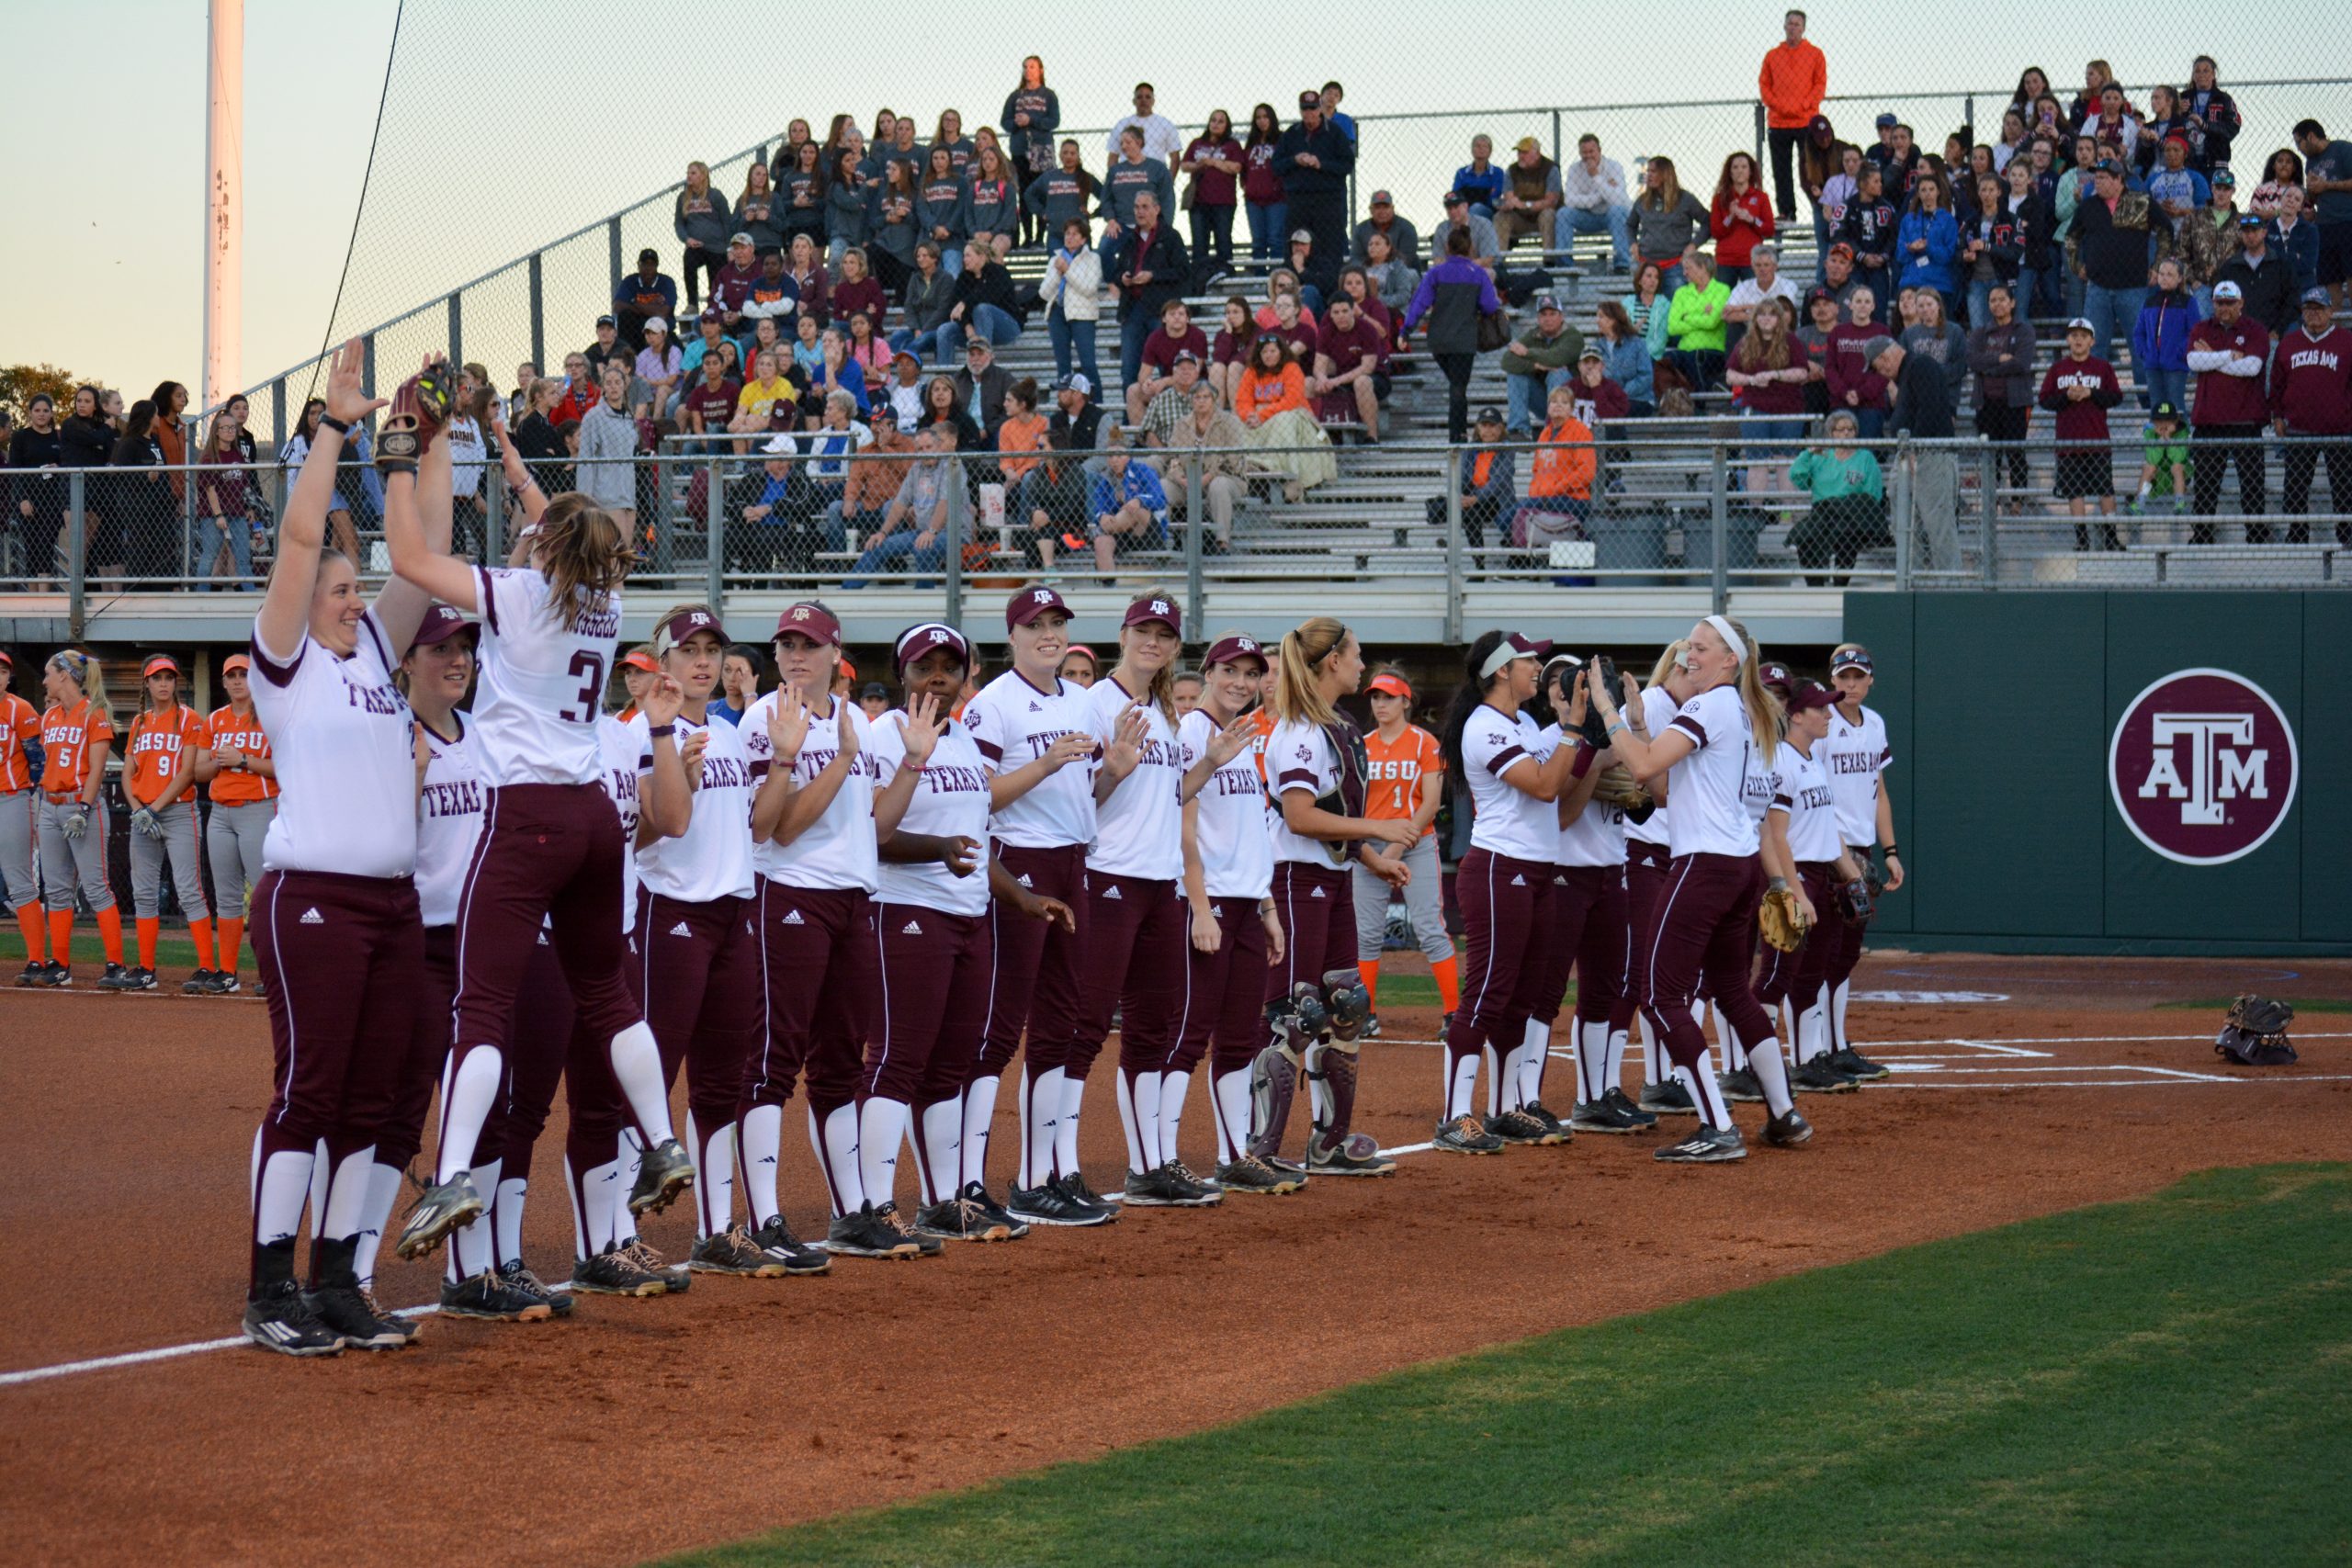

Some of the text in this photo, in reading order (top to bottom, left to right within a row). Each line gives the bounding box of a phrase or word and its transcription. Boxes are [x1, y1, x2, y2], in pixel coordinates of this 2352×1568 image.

[2290, 349, 2338, 371] TEXAS A&M
[2057, 375, 2078, 389] GIG
[560, 649, 605, 723] 3
[349, 682, 397, 716] TXAS
[43, 728, 84, 745] SHSU
[132, 733, 182, 752] SHSU
[59, 748, 72, 768] 5
[158, 756, 171, 776] 9
[801, 749, 861, 781] TEXS
[1831, 752, 1868, 775] TEXAS
[701, 759, 739, 790] EXAS
[923, 764, 980, 794] TEXAS
[1214, 768, 1257, 796] TEXAS
[1368, 761, 1417, 781] HSU
[422, 779, 481, 818] TEXAS
[1393, 785, 1403, 808] 1
[1800, 785, 1832, 810] TEXAS
[670, 930, 693, 938] adidas
